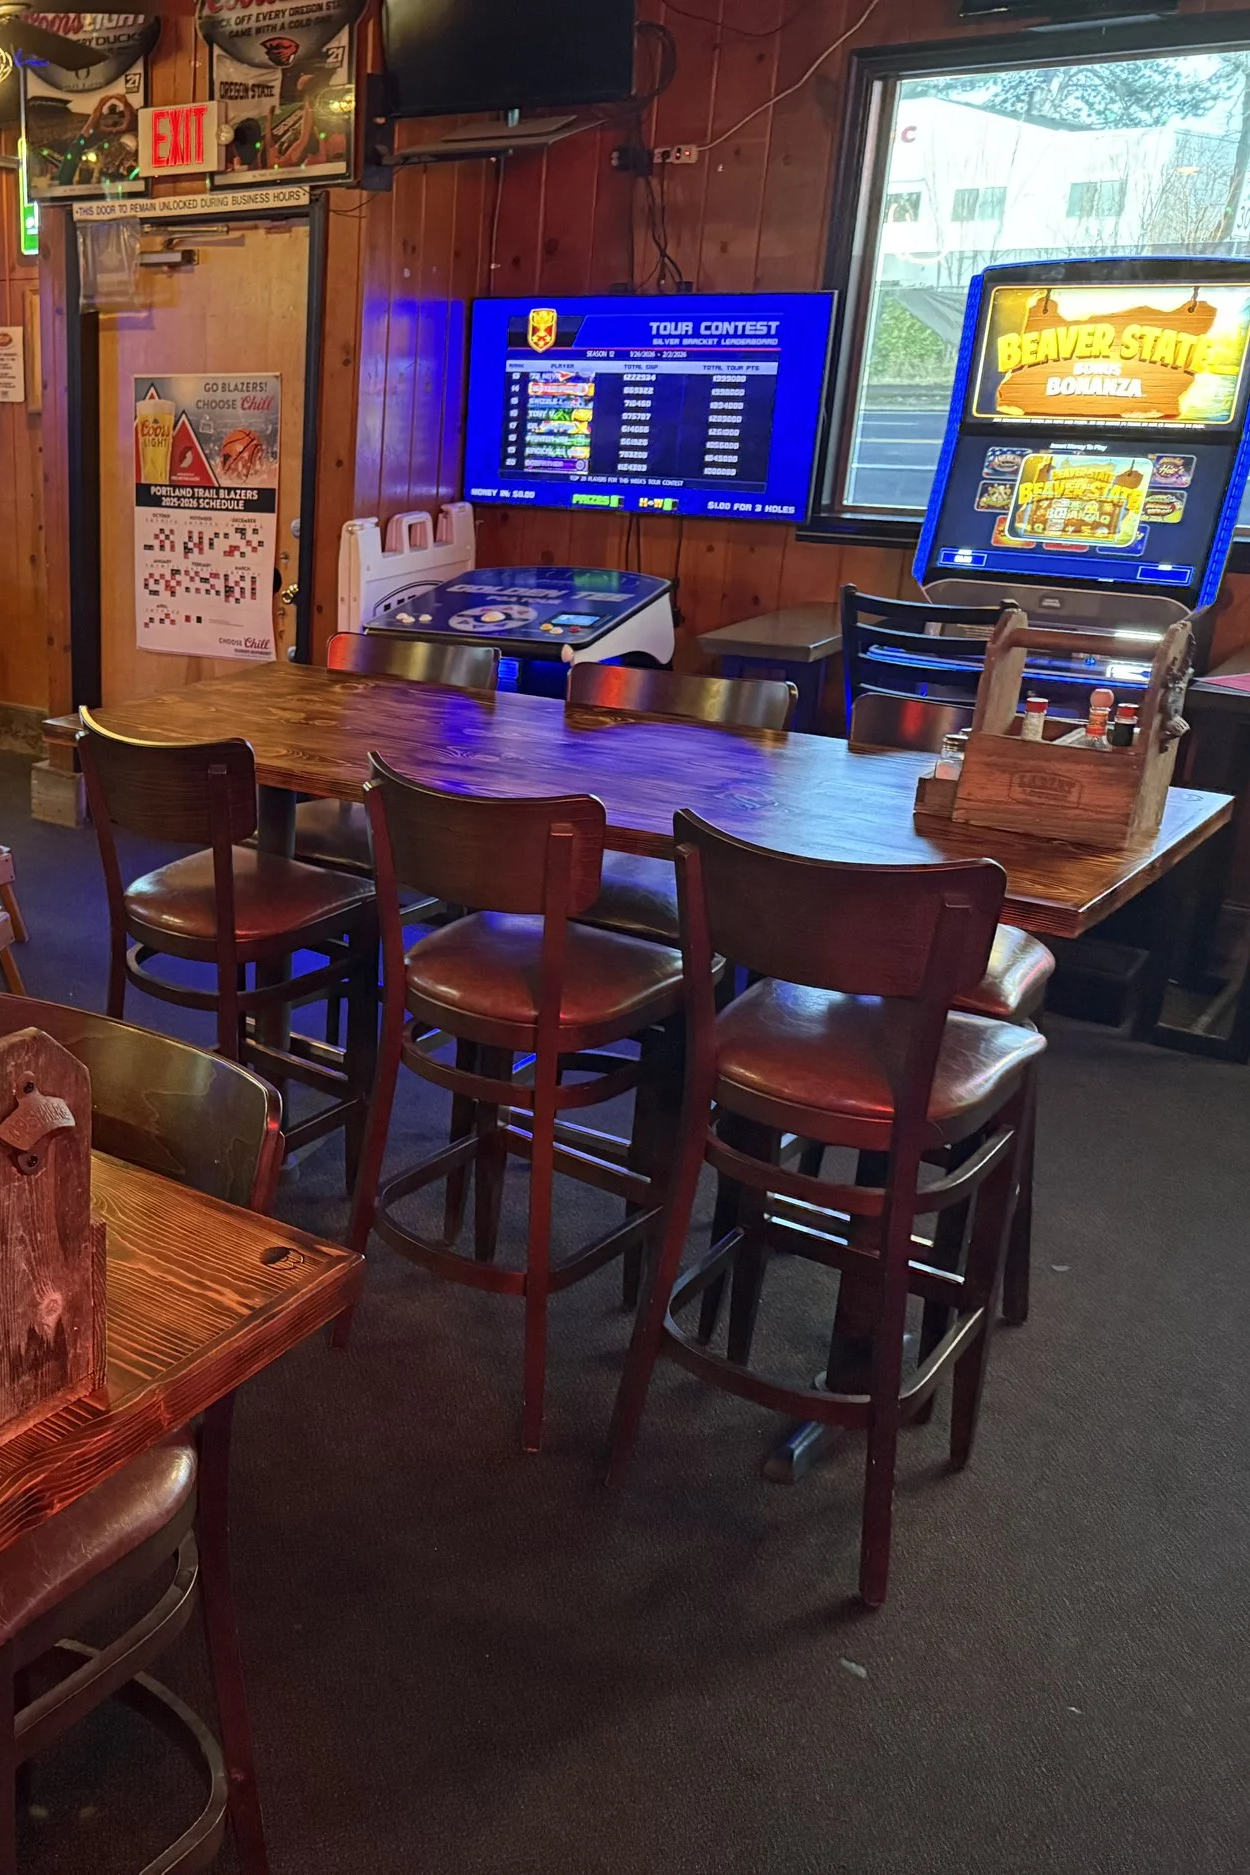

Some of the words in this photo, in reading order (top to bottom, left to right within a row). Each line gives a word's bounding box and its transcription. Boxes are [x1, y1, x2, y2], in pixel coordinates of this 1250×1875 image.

[235, 15, 253, 27] OFF
[255, 9, 287, 23] EVERY
[288, 4, 323, 16] OREGON
[228, 30, 253, 39] GAME
[255, 23, 278, 35] WITH
[279, 22, 286, 32] A
[288, 18, 312, 29] COLD
[219, 80, 250, 100] OREGON
[251, 82, 276, 99] STATE
[152, 105, 207, 168] EXIT
[78, 206, 94, 216] THIS
[96, 205, 116, 215] DOOR
[118, 203, 128, 213] TO
[130, 202, 156, 213] REMAIN
[159, 199, 197, 211] UNLOCKED
[200, 196, 229, 208] DURING
[231, 192, 270, 206] BUSINESS
[273, 190, 301, 202] HOURS
[649, 321, 693, 335] TOUR
[700, 321, 780, 335] CONTEST
[997, 322, 1116, 373] BEAVER
[1118, 323, 1224, 377] STATE
[203, 382, 219, 393] GO
[221, 382, 268, 393] BLAZERS!
[1046, 377, 1143, 397] BONANZA
[196, 399, 237, 410] CHOOSE
[240, 395, 275, 411] Chill
[141, 420, 170, 438] Coors
[144, 438, 168, 448] LIGHT
[151, 486, 193, 498] PORTLAND
[194, 488, 217, 499] TRAIL
[219, 490, 258, 501] BLAZERS
[470, 488, 498, 496] MONEY
[162, 497, 198, 508] 2025-2026
[199, 499, 244, 510] SCHEDULE
[707, 501, 731, 510] $1.00
[733, 503, 752, 511] FOR
[764, 504, 795, 514] HOLES
[218, 637, 242, 647] CHOOSE
[244, 637, 270, 650] Chill
